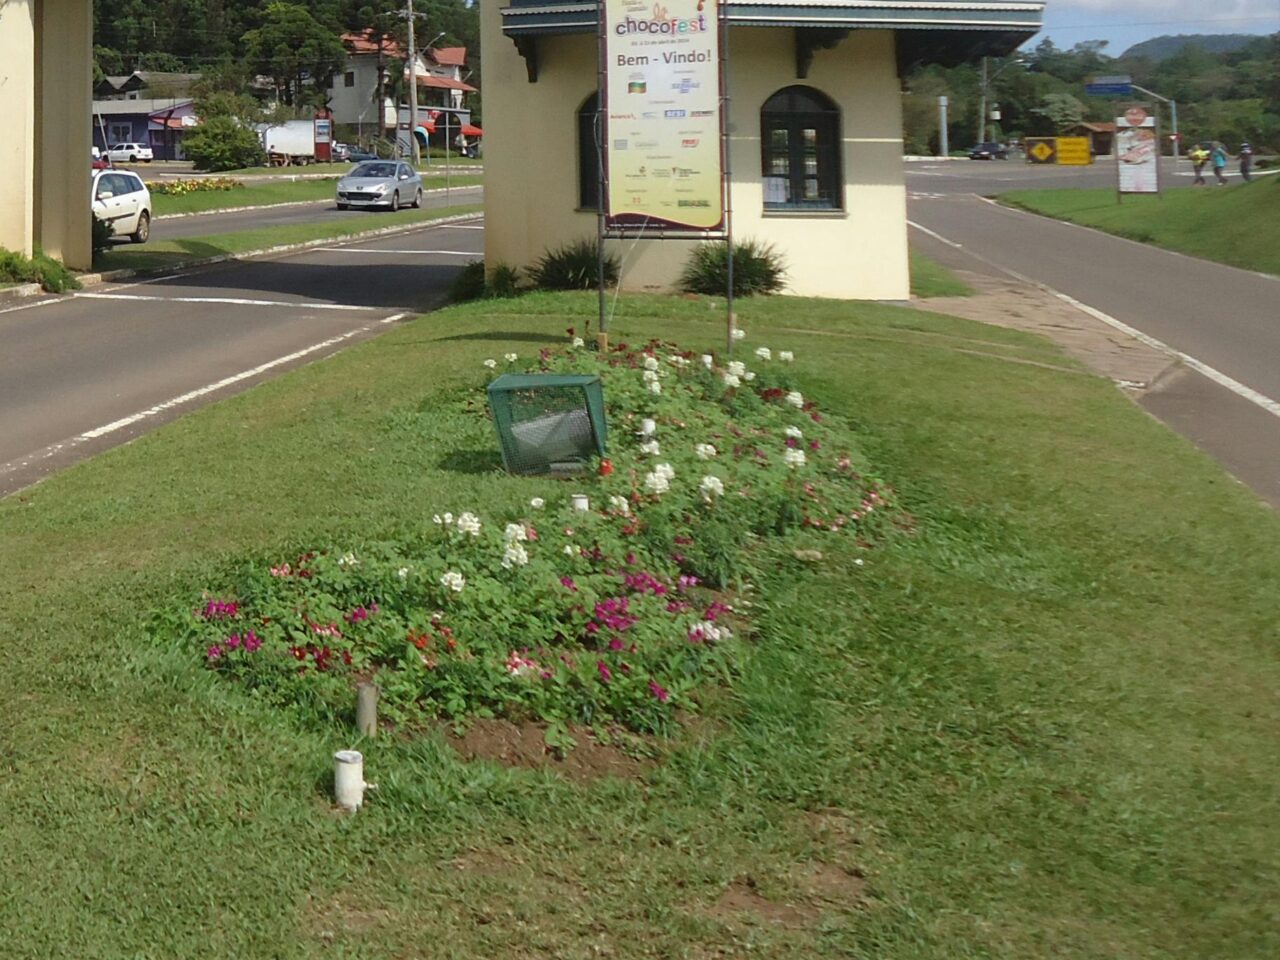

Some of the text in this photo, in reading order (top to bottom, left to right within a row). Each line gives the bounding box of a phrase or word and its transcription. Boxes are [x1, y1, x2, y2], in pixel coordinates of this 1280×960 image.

[615, 14, 706, 36] chocofest
[617, 54, 649, 67] Bem
[662, 48, 711, 64] Vindo!
